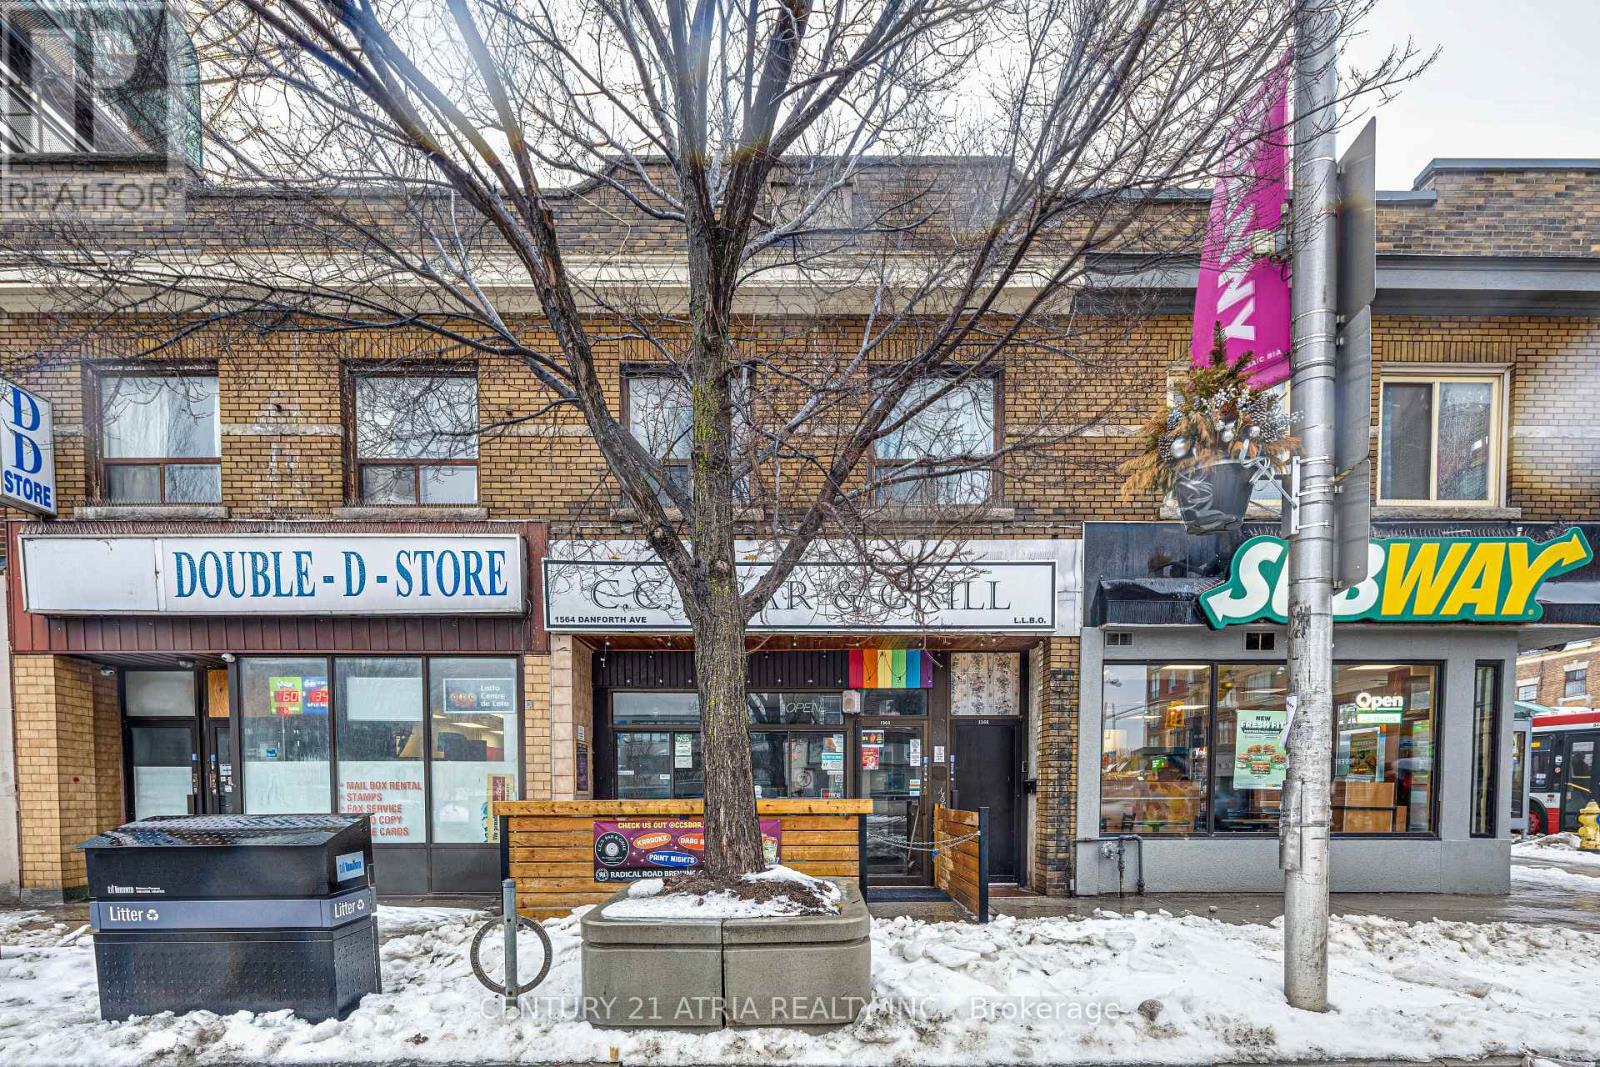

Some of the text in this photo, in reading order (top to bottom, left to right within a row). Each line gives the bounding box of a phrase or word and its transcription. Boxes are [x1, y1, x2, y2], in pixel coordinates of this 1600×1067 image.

[8, 385, 41, 432] D
[10, 429, 43, 474] D
[4, 469, 52, 508] STORE
[172, 550, 316, 599] DOUBLE
[342, 550, 367, 597] D
[396, 549, 508, 598] STORE
[1207, 533, 1588, 621] SBWAY
[879, 579, 1012, 611] GRILL
[554, 616, 648, 624] 1564 DANFORTH AVE
[1013, 616, 1047, 625] L.L.B.O.
[480, 684, 500, 692] Lotto
[1356, 692, 1404, 710] Open
[785, 702, 822, 713] OPEN
[346, 781, 422, 790] MAIL BOX RENTAL
[346, 792, 383, 801] STAMPS
[346, 804, 403, 813] FAX SERVICE
[379, 815, 403, 825] COPY
[379, 827, 409, 836] CARDS
[648, 854, 695, 864] PAINT NIGHTS
[109, 905, 144, 921] Litter
[334, 901, 356, 919] Litter
